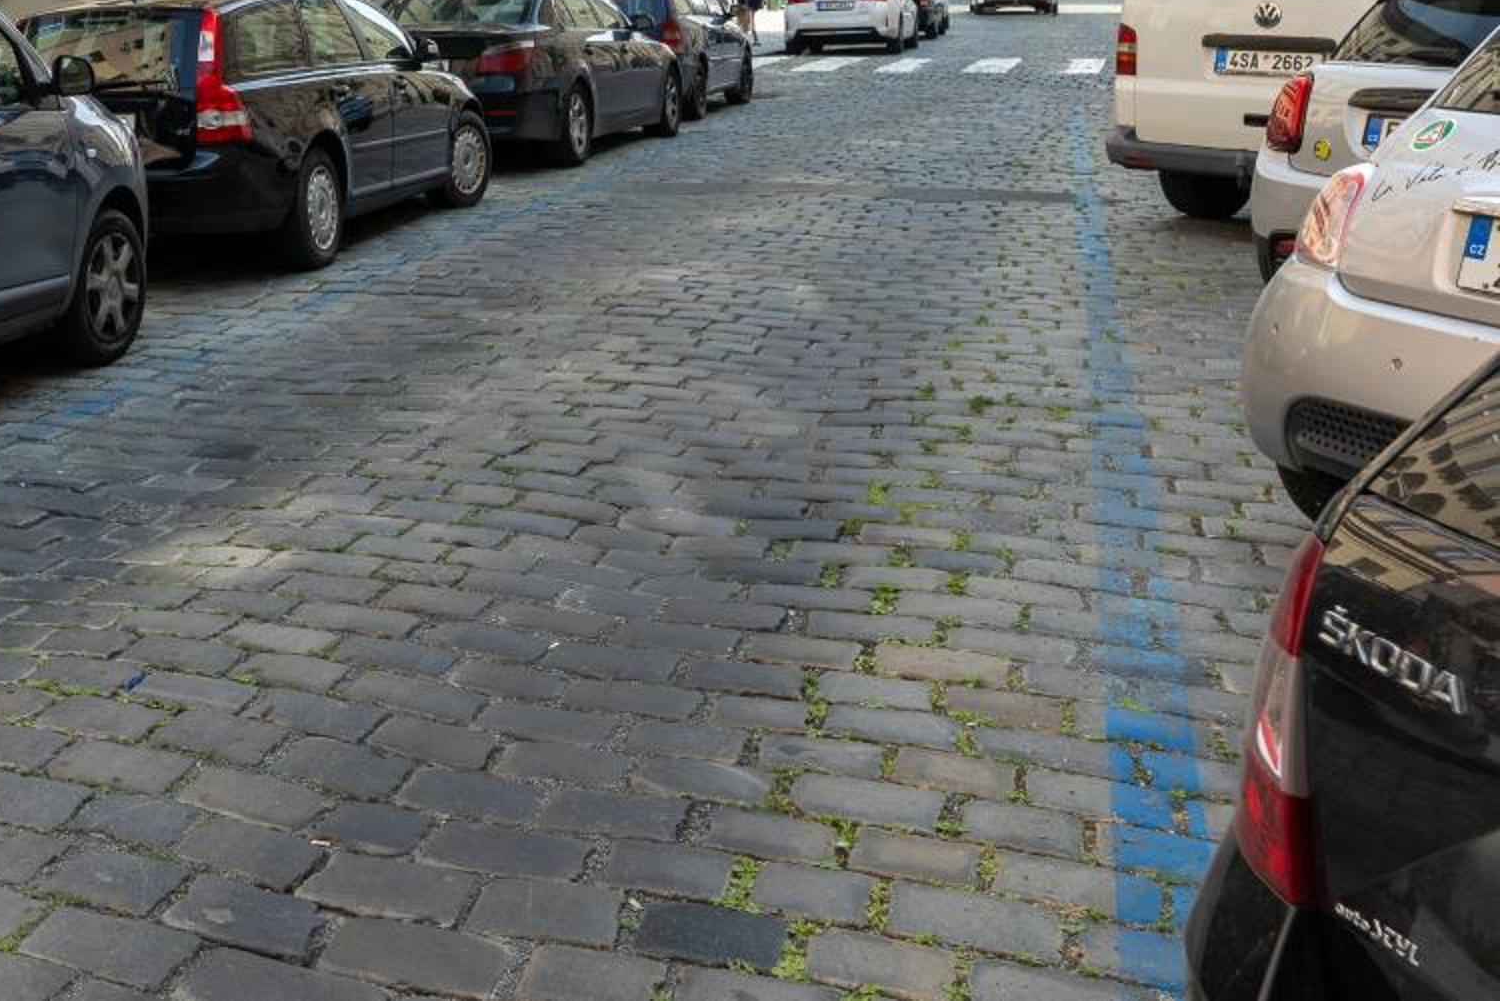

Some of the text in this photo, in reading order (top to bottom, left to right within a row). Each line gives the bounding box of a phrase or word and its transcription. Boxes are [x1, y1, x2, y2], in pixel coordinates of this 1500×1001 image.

[1229, 53, 1259, 69] 4SA
[1469, 244, 1485, 256] CZ
[1317, 604, 1469, 715] ŠKODA
